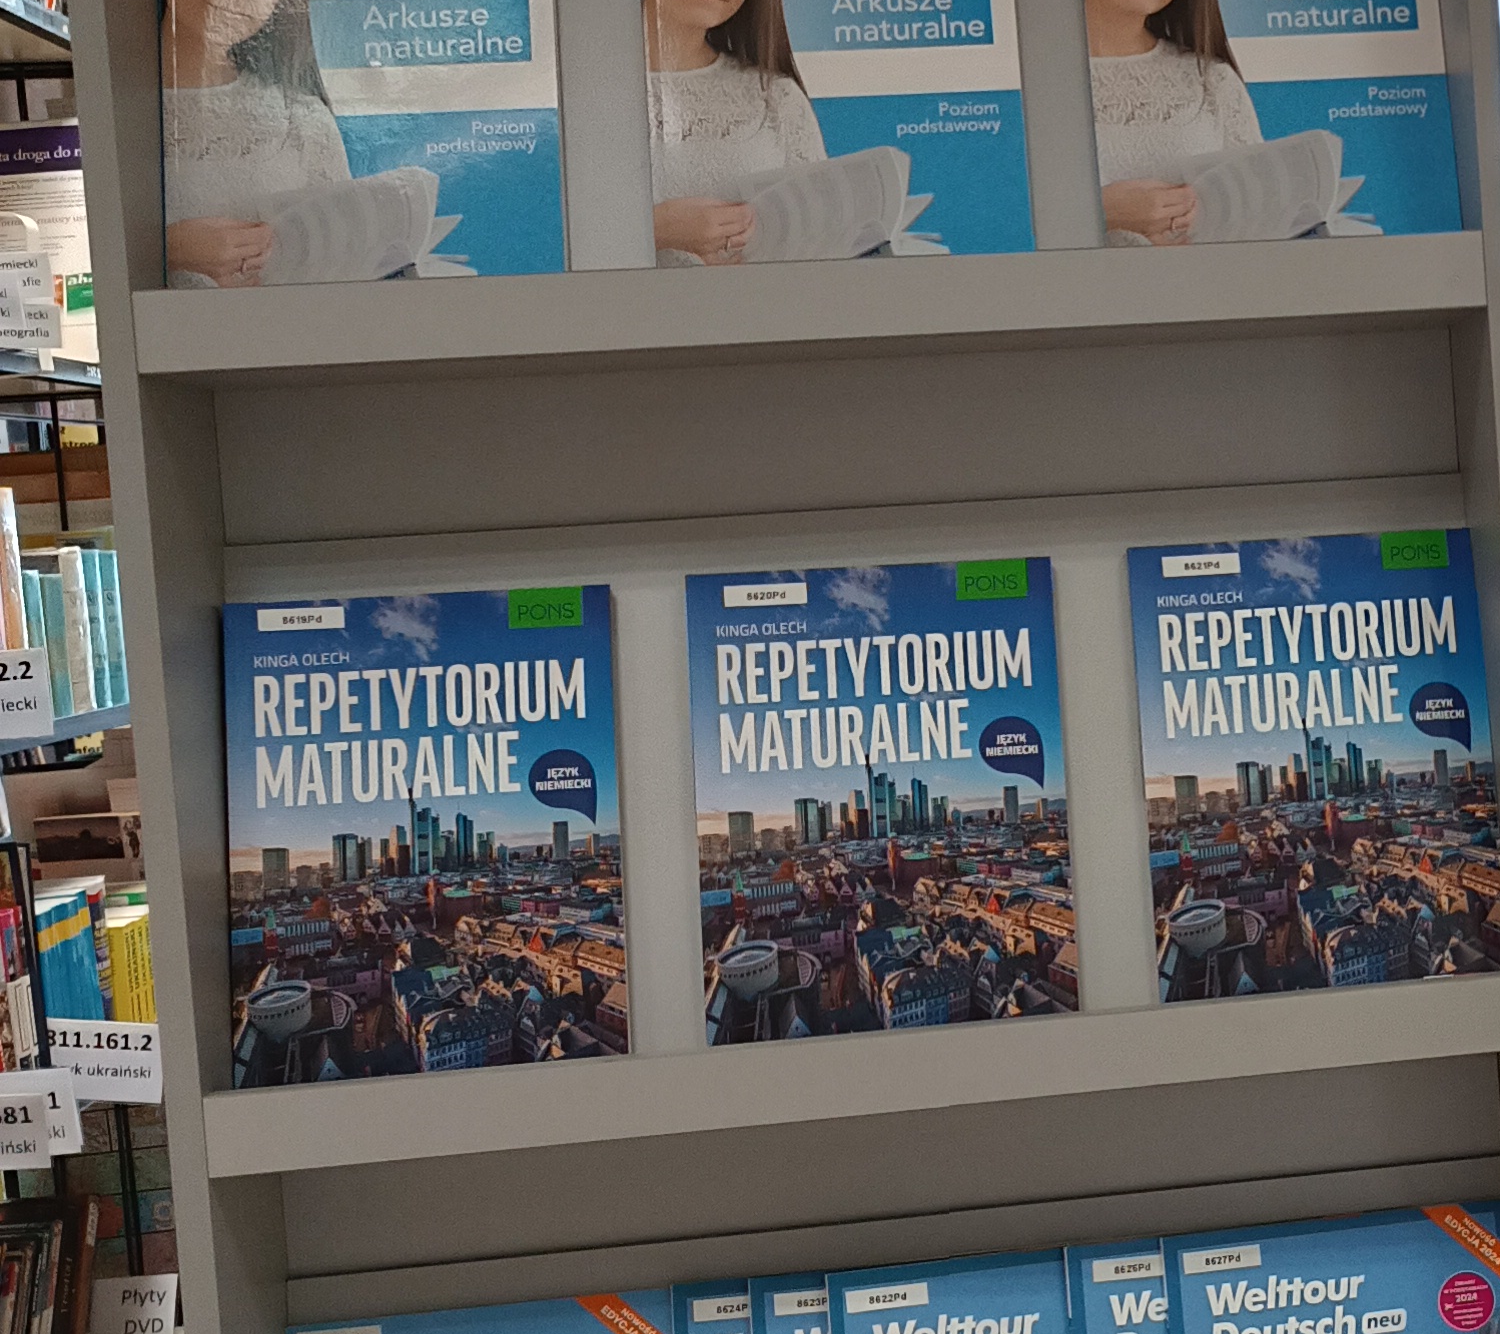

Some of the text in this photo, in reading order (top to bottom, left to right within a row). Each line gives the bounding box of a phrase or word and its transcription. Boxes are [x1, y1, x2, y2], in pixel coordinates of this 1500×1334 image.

[362, 4, 489, 32] Arkusze
[1266, 1, 1410, 30] maturalne
[834, 13, 985, 44] maturalne
[364, 30, 524, 60] maturalne
[1367, 85, 1426, 101] Poziom
[938, 100, 1000, 117] Poziom
[1328, 100, 1428, 122] podstawowy
[471, 119, 536, 136] Poziom
[895, 116, 1002, 138] podstawowy
[13, 146, 71, 164] droga do
[426, 136, 537, 157] podstawowy
[1389, 544, 1440, 562] PONS
[964, 574, 1018, 592] PONS
[518, 602, 574, 621] PONS
[1157, 595, 1458, 673] REPETYTORIUM
[0, 660, 33, 682] 2.2
[717, 627, 1033, 705] REPETYTORIUM
[253, 657, 587, 738] REPETYTORIUM
[1162, 665, 1403, 739] MATURALNE
[719, 698, 972, 774] MATURALNE
[255, 731, 521, 809] MATURALNE
[48, 1030, 153, 1052] 811.161.2
[87, 1064, 151, 1079] ukraiński
[0, 1140, 36, 1155] iński
[121, 1288, 167, 1308] Płyty
[1205, 1275, 1364, 1316] Welttour
[1366, 1311, 1402, 1329] neu
